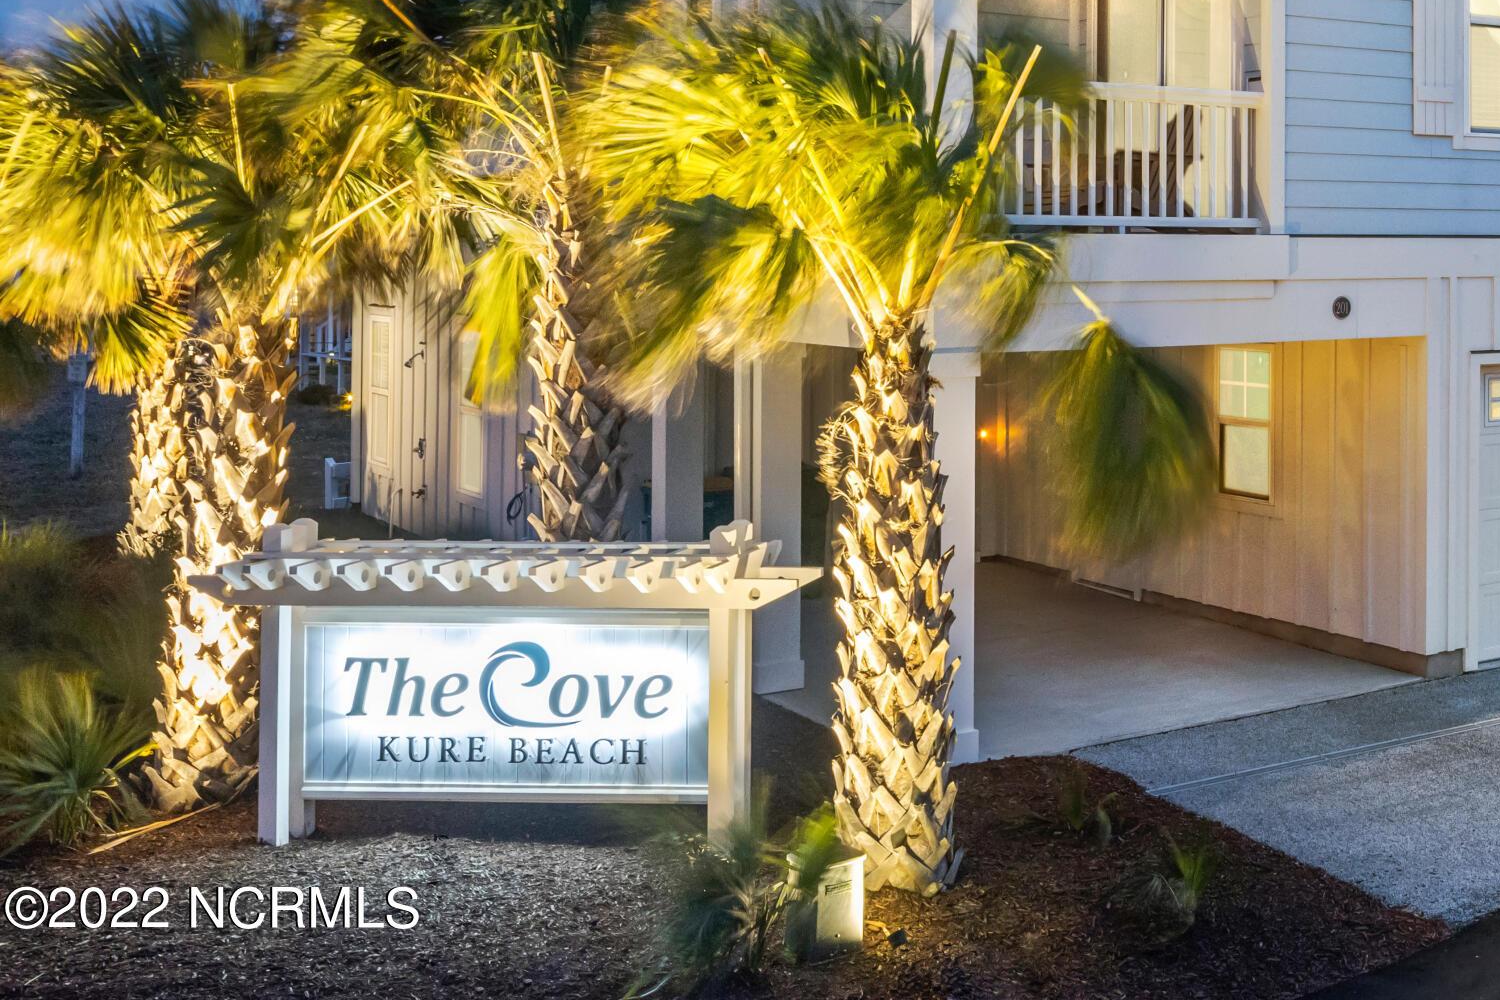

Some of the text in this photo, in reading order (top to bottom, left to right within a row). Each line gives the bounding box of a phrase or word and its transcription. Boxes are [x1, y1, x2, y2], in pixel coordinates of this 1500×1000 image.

[1335, 301, 1349, 314] 201
[343, 640, 674, 729] The Cove
[376, 735, 648, 766] KURE BEACH
